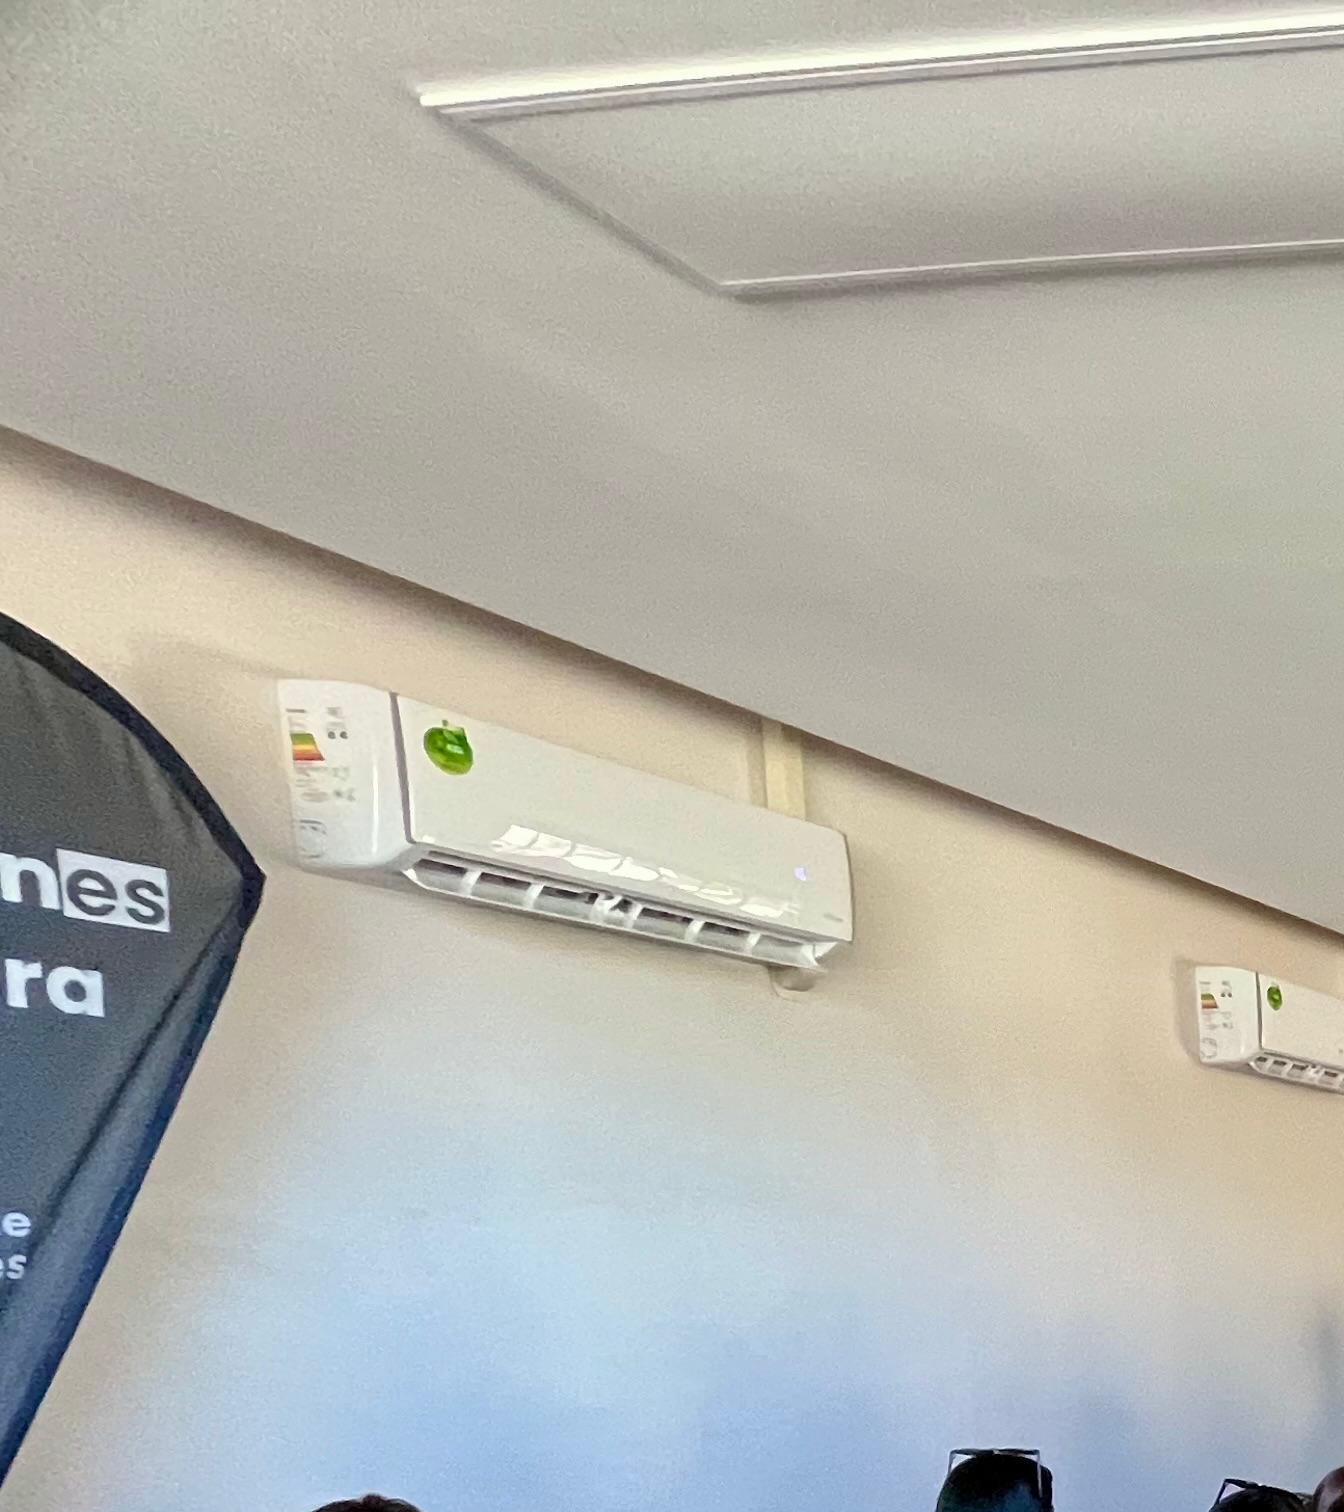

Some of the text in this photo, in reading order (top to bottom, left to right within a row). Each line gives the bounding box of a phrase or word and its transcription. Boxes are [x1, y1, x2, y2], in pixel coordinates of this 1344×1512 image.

[0, 853, 166, 925] nes
[5, 958, 105, 1018] ra
[0, 1254, 27, 1279] s
